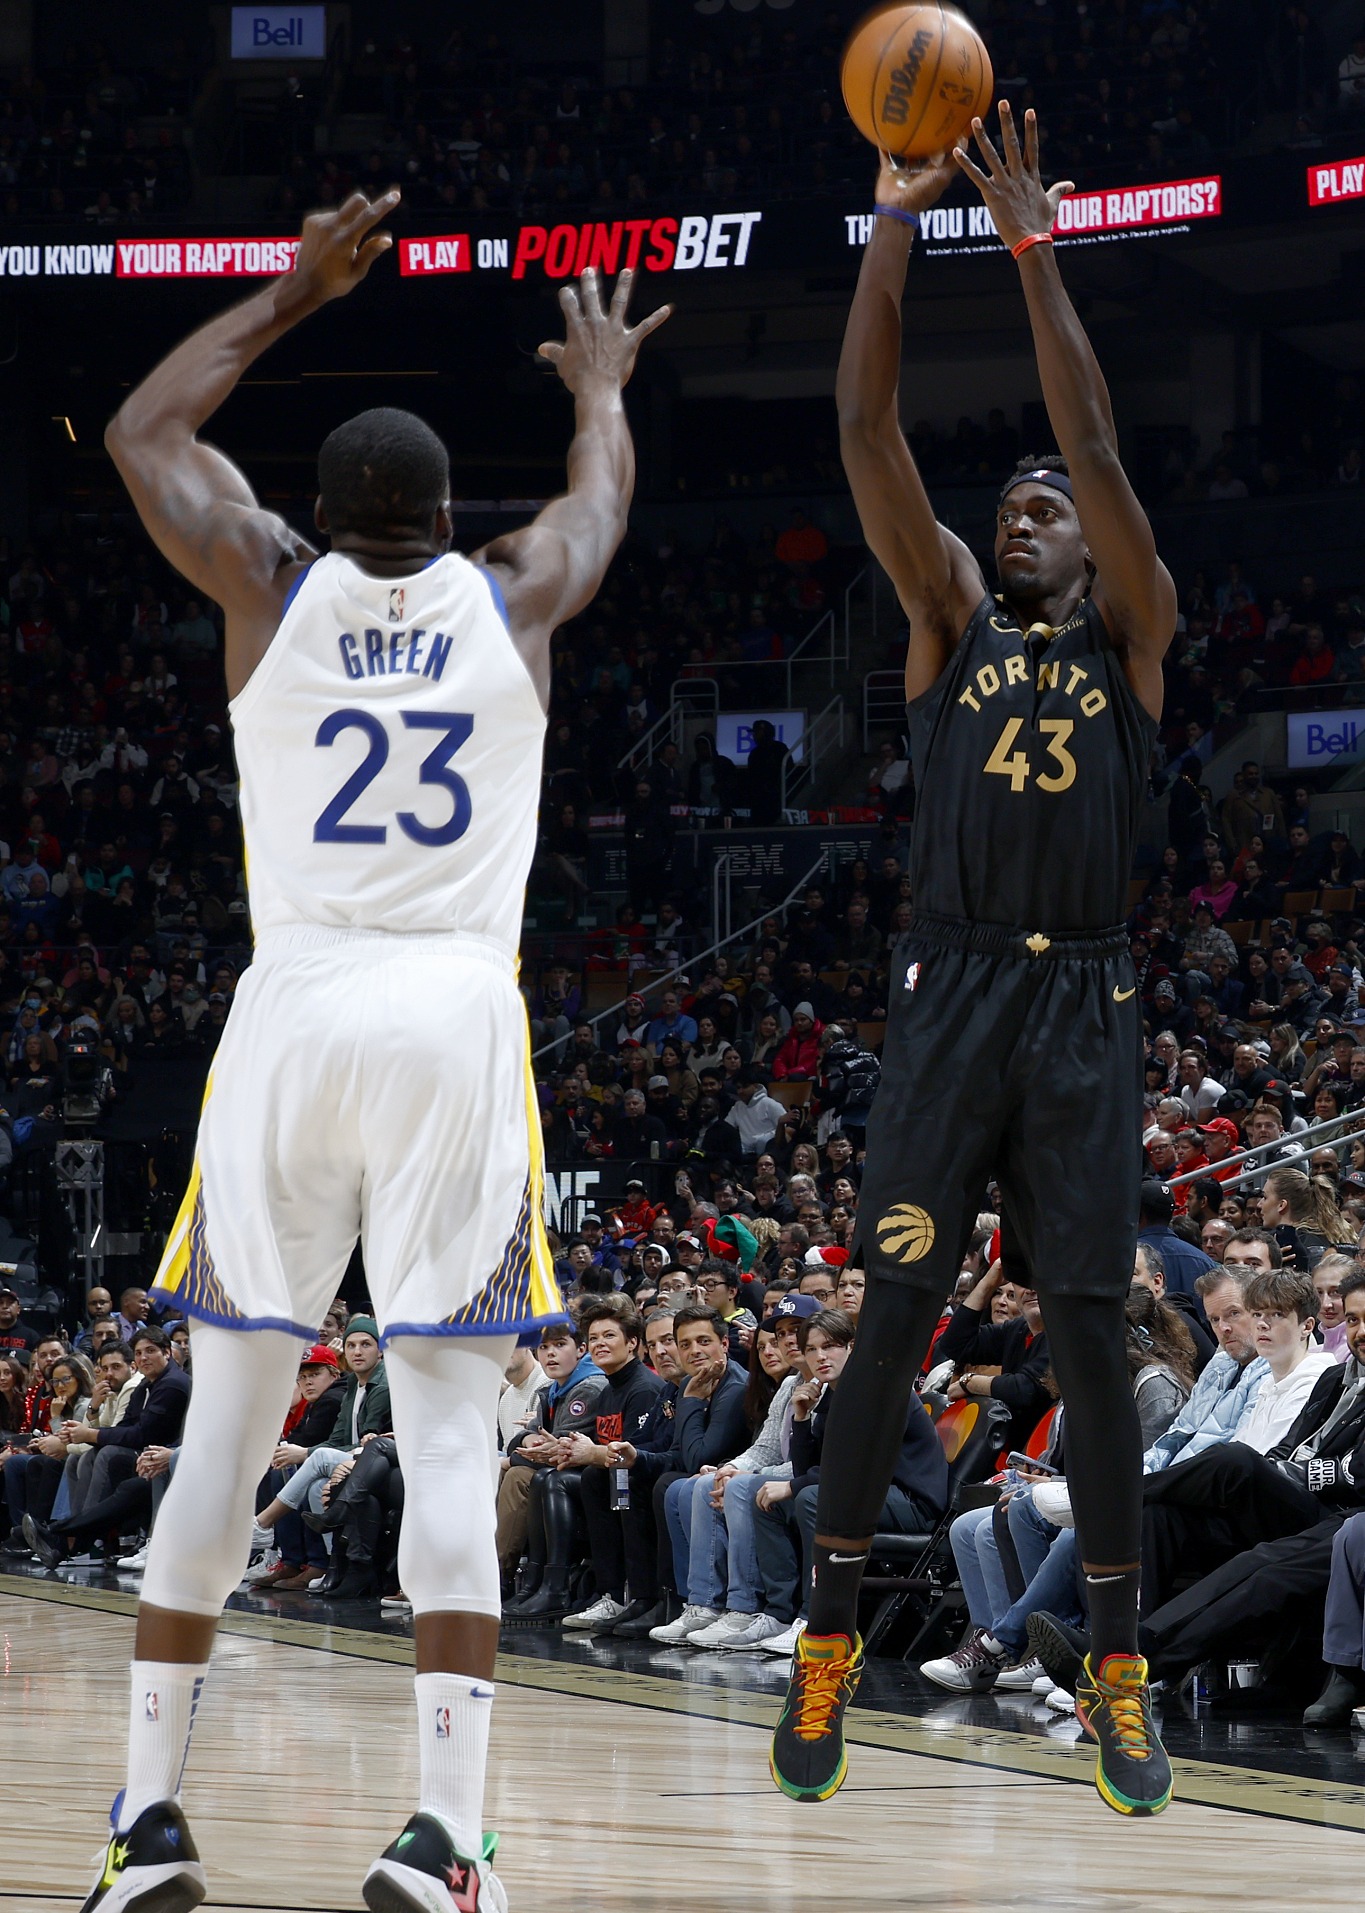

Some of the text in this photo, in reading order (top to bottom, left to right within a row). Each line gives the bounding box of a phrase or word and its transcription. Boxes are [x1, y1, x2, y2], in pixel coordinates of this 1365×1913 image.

[252, 17, 303, 47] Bell
[881, 29, 934, 126] Wilson
[1316, 163, 1365, 199] PLAY
[919, 208, 963, 240] YOU
[1056, 196, 1103, 230] OUR
[1106, 181, 1218, 224] RAPTORS?
[45, 245, 114, 274] KNOW
[118, 243, 181, 274] YOUR
[408, 211, 762, 280] PLAY ON POINTSBET
[338, 628, 454, 683] GREEN
[958, 653, 1108, 718] TORNTO
[982, 716, 1078, 793] 43
[1306, 721, 1358, 756] Bell
[312, 707, 475, 848] 23
[1321, 1460, 1334, 1485] OUR
